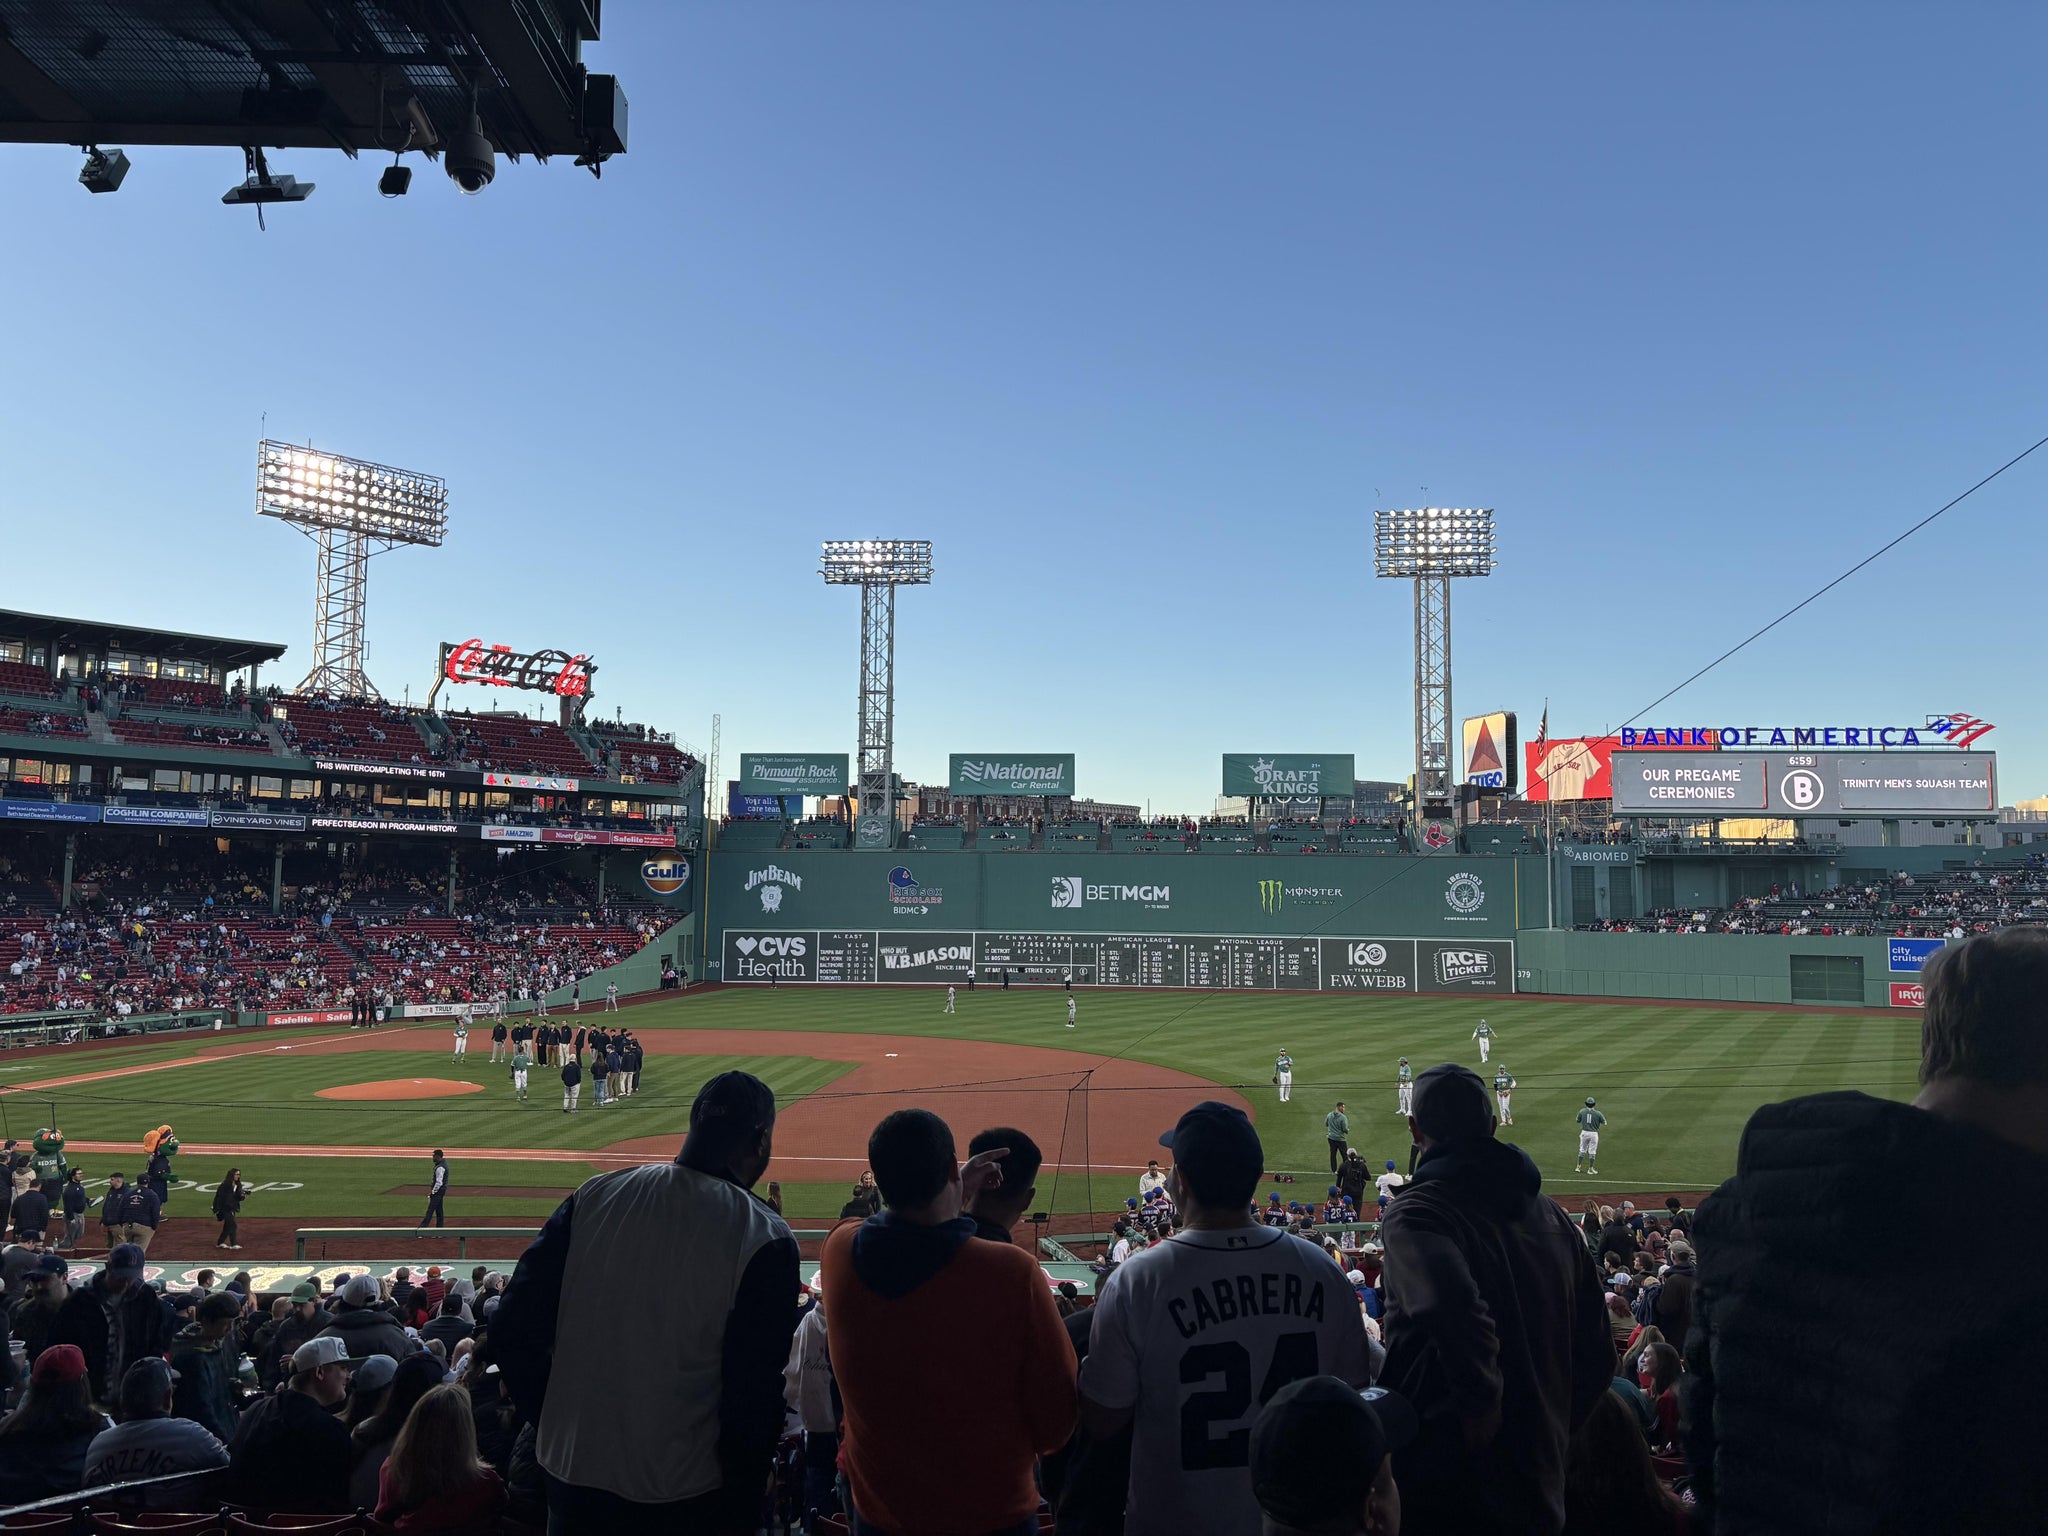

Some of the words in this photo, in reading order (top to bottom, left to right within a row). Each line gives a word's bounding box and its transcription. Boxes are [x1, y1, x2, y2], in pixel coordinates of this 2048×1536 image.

[1621, 727, 1707, 746] BANK
[1720, 727, 1757, 746] OF
[1769, 727, 1920, 746] AMERICA
[1568, 762, 1580, 771] SOX
[1789, 757, 1812, 765] 6:59
[316, 762, 333, 770] THIS
[335, 763, 411, 775] WINTERCOMPLETING
[752, 765, 805, 778] Plymouth
[809, 765, 837, 777] Rock
[1254, 770, 1321, 784] DRAFT
[1643, 769, 1669, 781] OUR
[1675, 770, 1741, 782] PREGAME
[1012, 781, 1027, 789] Car
[1030, 781, 1059, 789] Rental
[1262, 783, 1319, 794] KINGS
[1843, 779, 1881, 788] TRINITY
[1884, 779, 1912, 788] MEN'S
[1916, 779, 1956, 789] SQUASH
[1959, 780, 1987, 789] TEAM
[1650, 786, 1735, 799] CEREMONIES
[745, 797, 761, 805] Your
[107, 809, 149, 817] COGHLIN
[151, 811, 207, 820] COMPANIES
[223, 817, 272, 825] VINEYARD
[274, 818, 302, 826] VINES
[312, 819, 378, 829] PERFECTSEASON
[389, 822, 425, 831] PROGRAM
[426, 824, 457, 832] HISTORY.
[556, 832, 573, 840] Ninety
[1574, 852, 1628, 861] ABIOMED
[643, 864, 686, 878] Gulf
[744, 870, 768, 891] JIM
[768, 865, 802, 892] BEAM
[1447, 872, 1468, 885] IBEW
[1469, 874, 1482, 885] 103
[894, 888, 917, 896] RED
[920, 888, 943, 896] SOX
[1086, 885, 1170, 901] BETMGM
[1285, 887, 1342, 897] MONSTER
[893, 906, 919, 914] BIDMC
[759, 937, 806, 956] CVS
[1892, 947, 1910, 955] city
[1349, 943, 1387, 966] 160
[1446, 951, 1488, 966] ACE
[737, 958, 806, 977] Health
[1447, 965, 1488, 976] TICKET
[1518, 970, 1530, 978] 379
[1331, 975, 1357, 987] F.W.
[1361, 976, 1406, 988] WEBB
[1899, 991, 1924, 999] IRVI
[274, 1015, 313, 1025] Safelite
[1586, 1114, 1592, 1123] 11
[1142, 1216, 1157, 1228] 22
[1269, 1217, 1278, 1227] 4
[1167, 1273, 1325, 1340] CABRERA
